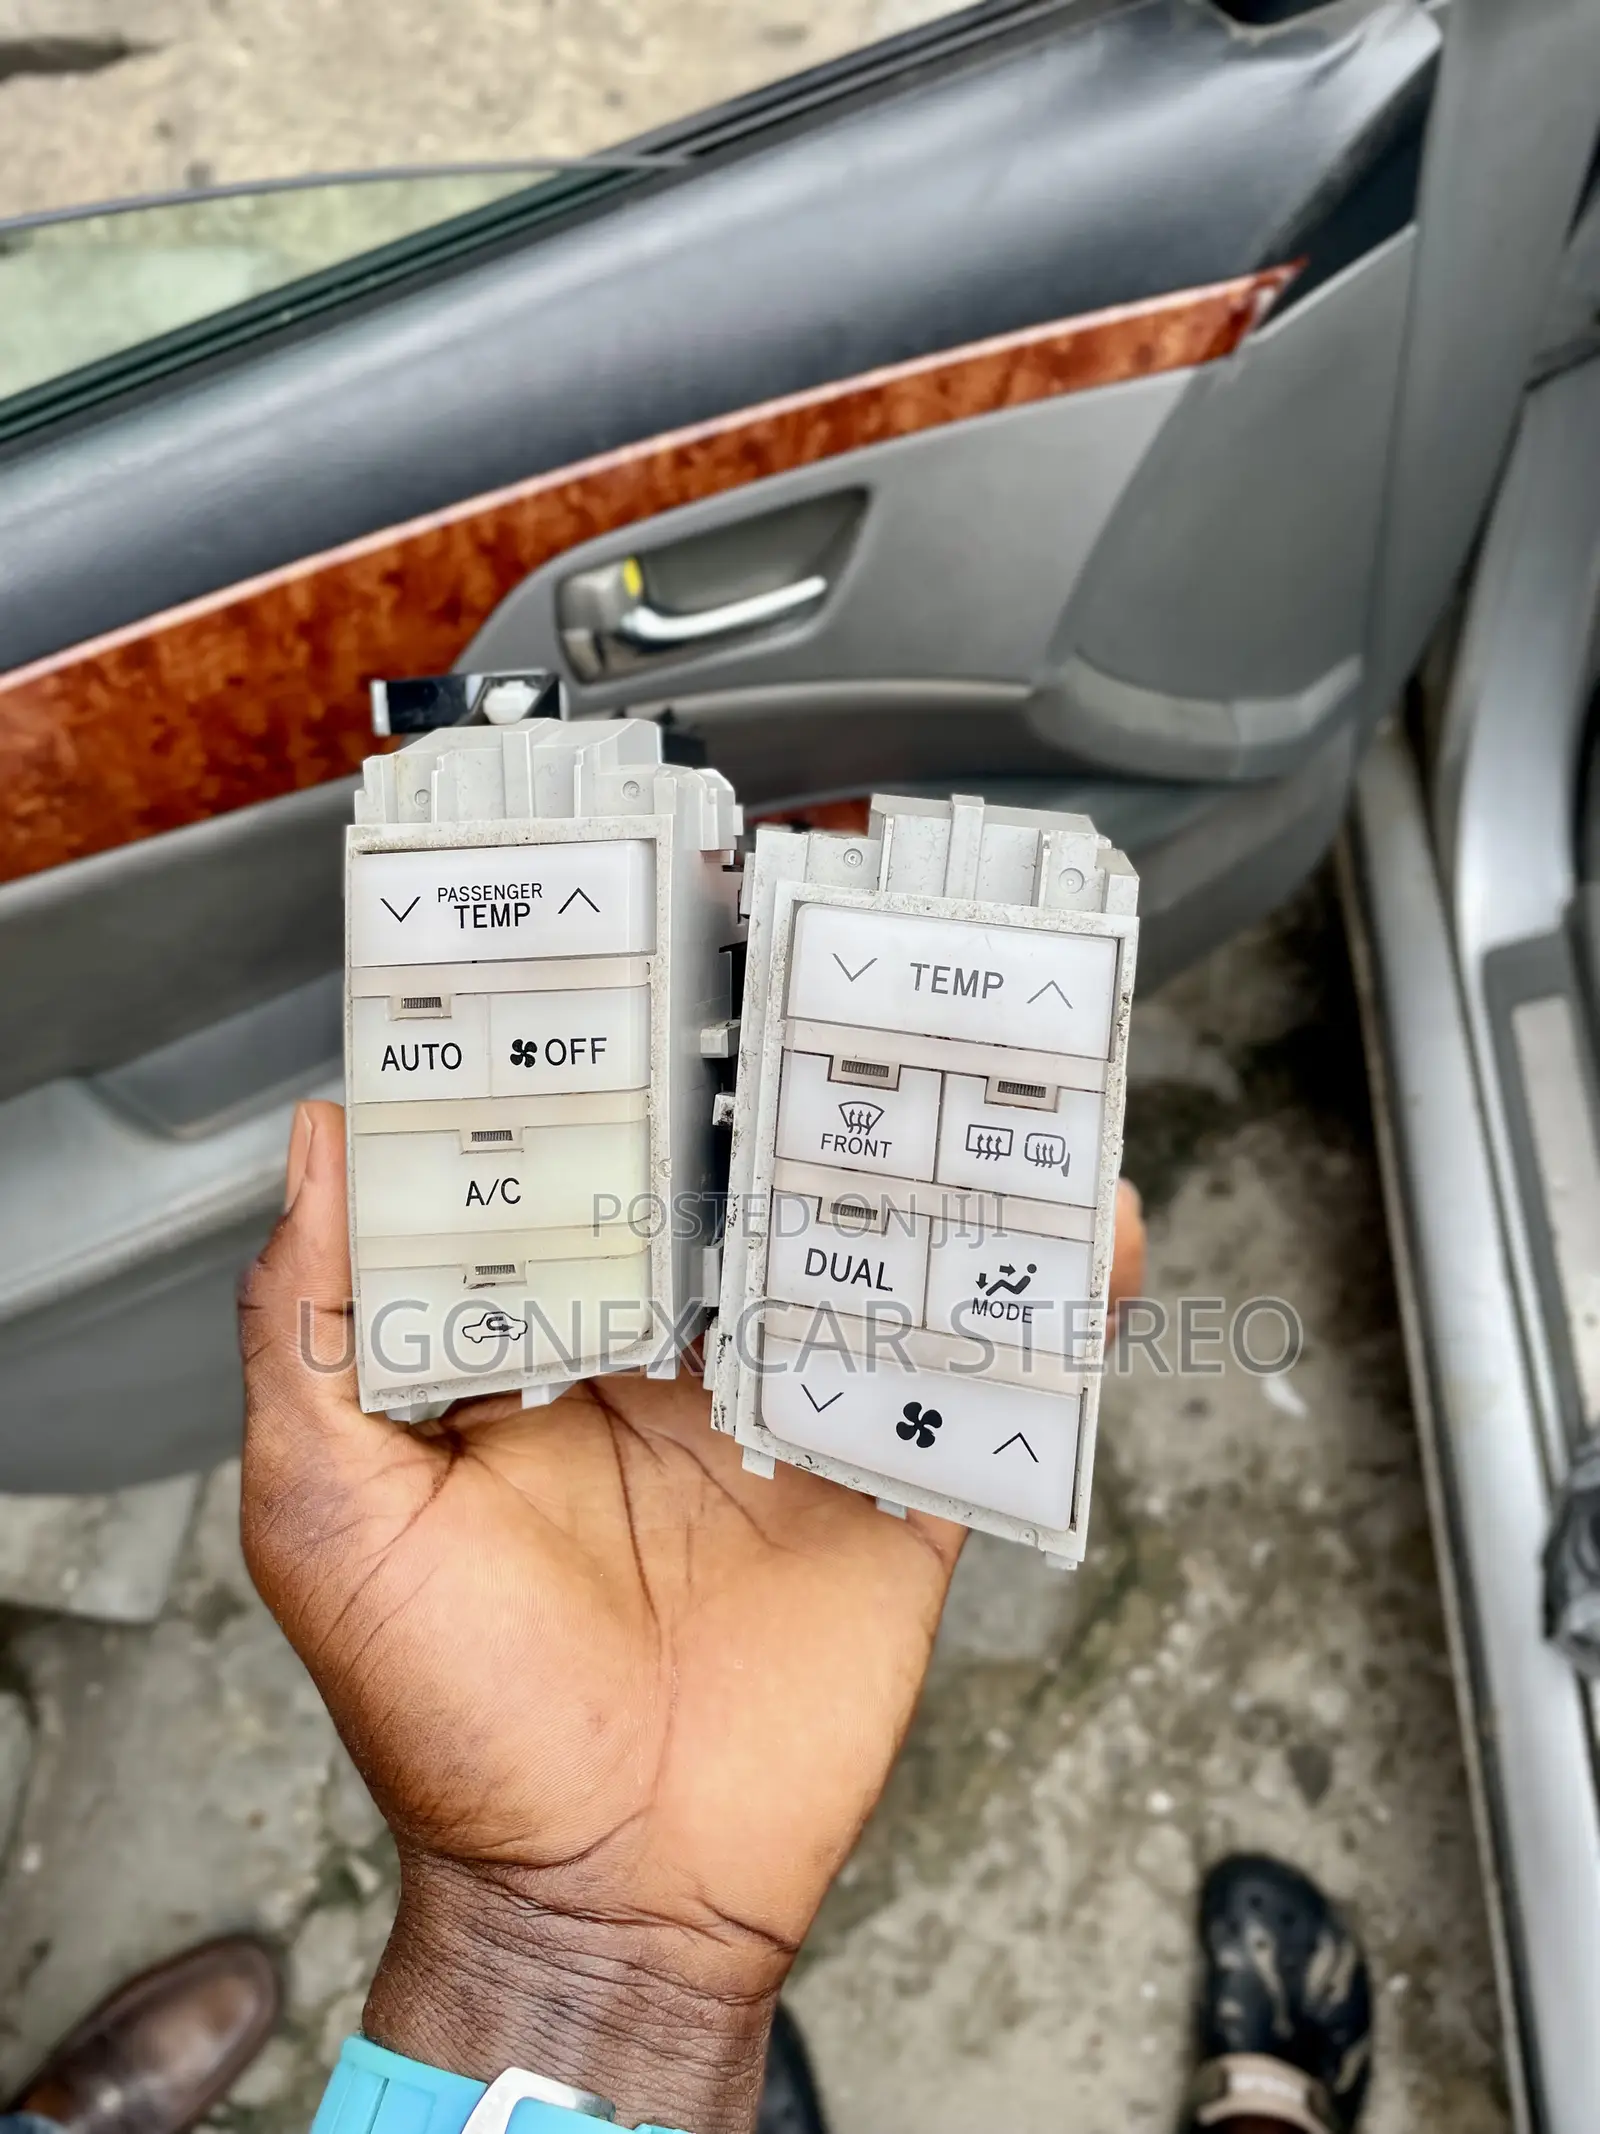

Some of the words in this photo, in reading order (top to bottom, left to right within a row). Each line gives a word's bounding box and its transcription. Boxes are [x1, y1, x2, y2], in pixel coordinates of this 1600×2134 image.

[437, 882, 543, 902] PASSENGER
[453, 902, 531, 930] TEMP
[910, 962, 1004, 1000] TEMP
[380, 1042, 463, 1072] AUTO
[545, 1037, 607, 1067] OFF
[820, 1133, 893, 1159] FRONT
[465, 1176, 522, 1207] A/C
[804, 1247, 894, 1292] DUAL
[971, 1299, 1034, 1325] MODE
